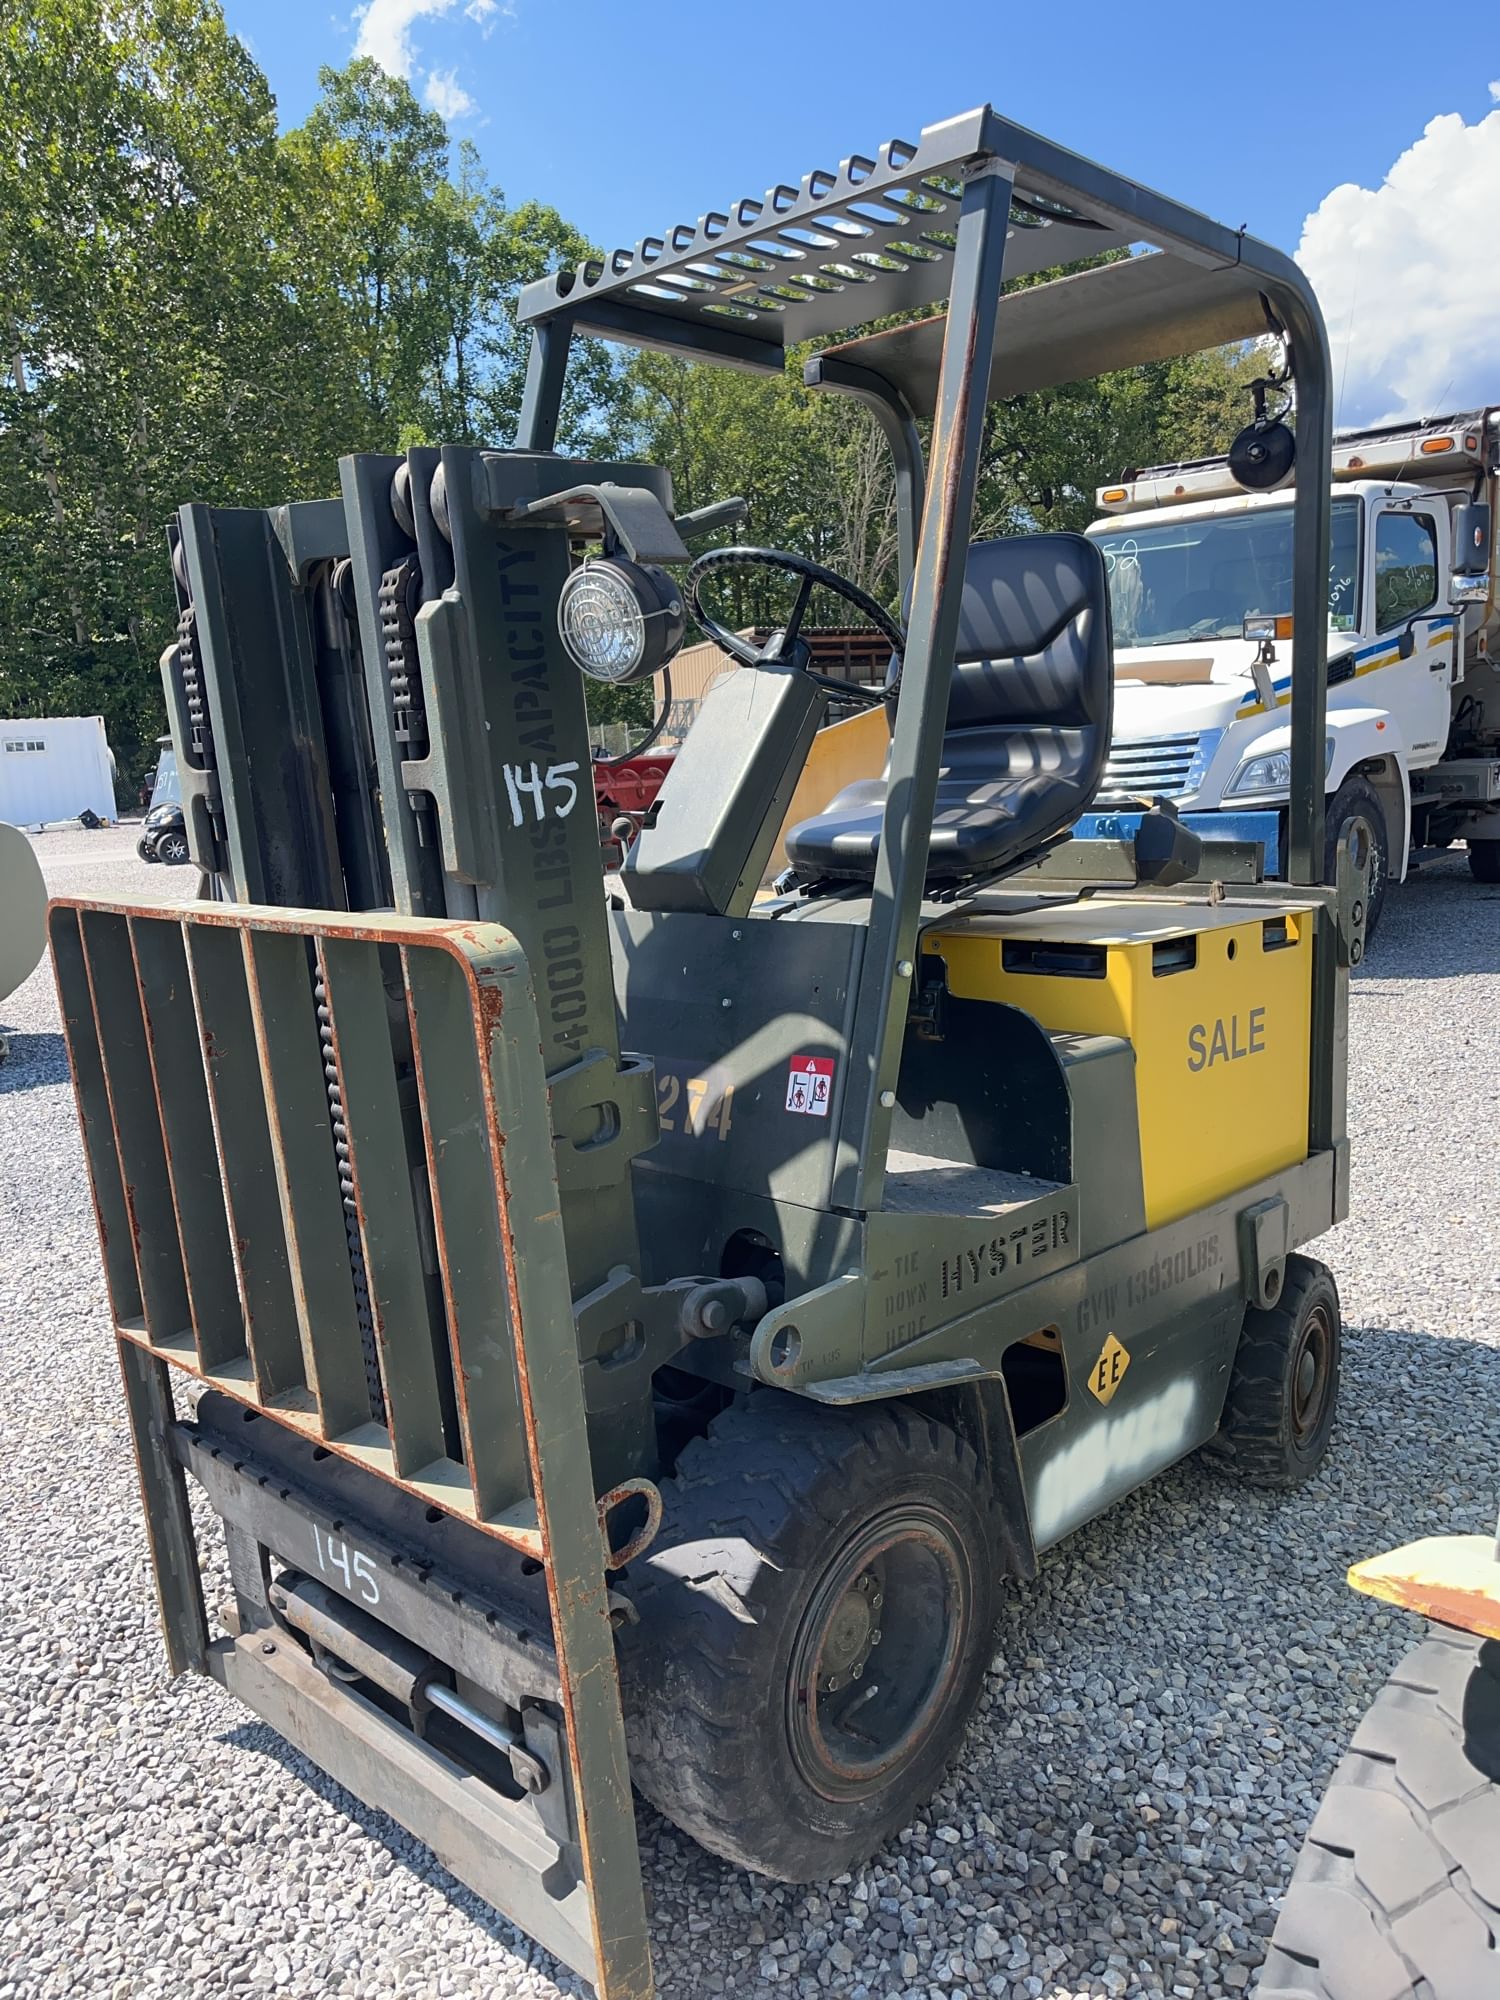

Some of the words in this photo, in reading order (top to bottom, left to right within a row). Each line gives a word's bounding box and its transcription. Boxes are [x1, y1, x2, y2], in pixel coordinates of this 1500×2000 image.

[502, 760, 580, 828] 145
[529, 816, 574, 911] LBS
[542, 925, 589, 1051] 4000
[1187, 1006, 1266, 1073] SALE
[658, 1074, 735, 1141] 274
[894, 1250, 920, 1279] TIE
[940, 1210, 1069, 1299] HYSTER
[884, 1281, 928, 1318] DOWN
[1077, 1283, 1119, 1335] GVW
[313, 1523, 380, 1604] 145
